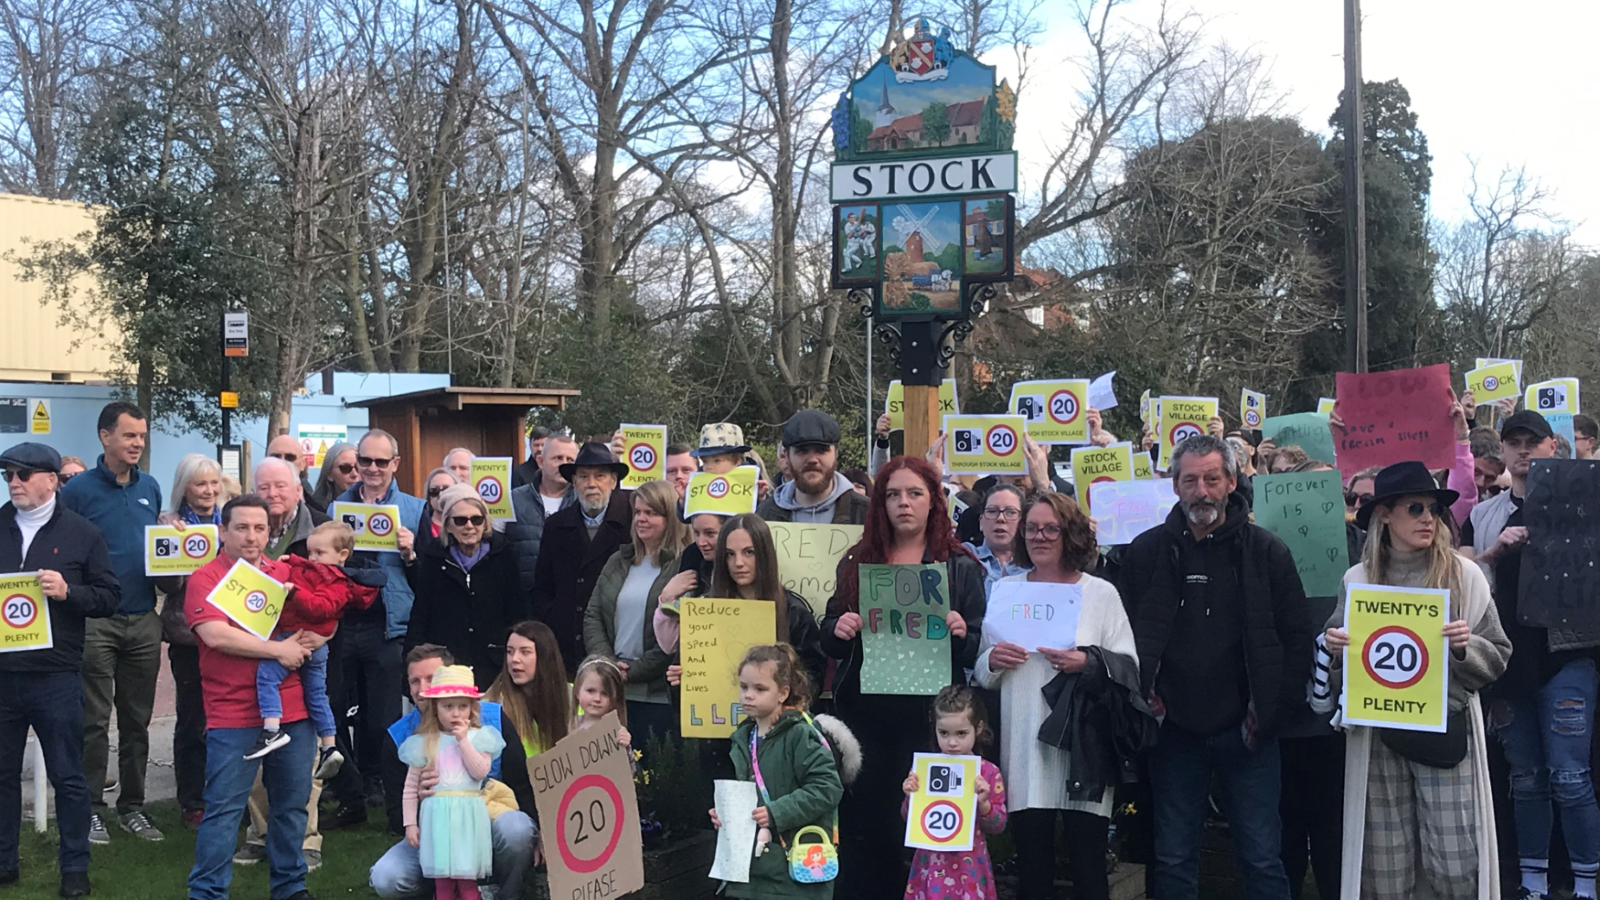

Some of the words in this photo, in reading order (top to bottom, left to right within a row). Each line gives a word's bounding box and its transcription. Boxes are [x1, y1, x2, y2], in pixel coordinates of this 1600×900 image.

[852, 158, 996, 197] STOCK
[1054, 399, 1075, 415] 20
[1172, 403, 1205, 413] STOCK
[1169, 412, 1208, 422] VILLAGE
[1248, 413, 1257, 423] 20
[625, 431, 662, 440] TWENTY'S
[990, 433, 1012, 447] 20
[633, 449, 653, 464] 20
[1083, 452, 1118, 465] STOCK
[472, 464, 507, 472] TWENTY'S
[1081, 463, 1123, 475] VILLAGE
[480, 483, 498, 496] 20
[1265, 479, 1329, 504] Forever
[489, 508, 506, 516] ENTY
[372, 519, 389, 530] 20
[188, 539, 206, 551] 20
[0, 580, 39, 590] WENTY'S
[869, 568, 943, 605] FOR
[8, 602, 32, 619] 20
[686, 602, 740, 618] Reduce
[1011, 604, 1055, 621] FRED
[1355, 600, 1439, 618] TWENTY'S
[687, 621, 715, 636] your
[869, 608, 949, 639] FRED
[5, 633, 40, 643] PLENTY
[686, 654, 706, 664] And
[1374, 642, 1418, 672] 20
[686, 684, 708, 692] Lives
[1363, 697, 1427, 715] PLENTY
[534, 753, 573, 793] SLOW
[579, 729, 621, 769] DOWN
[570, 799, 605, 845] 20
[928, 810, 956, 831] 20
